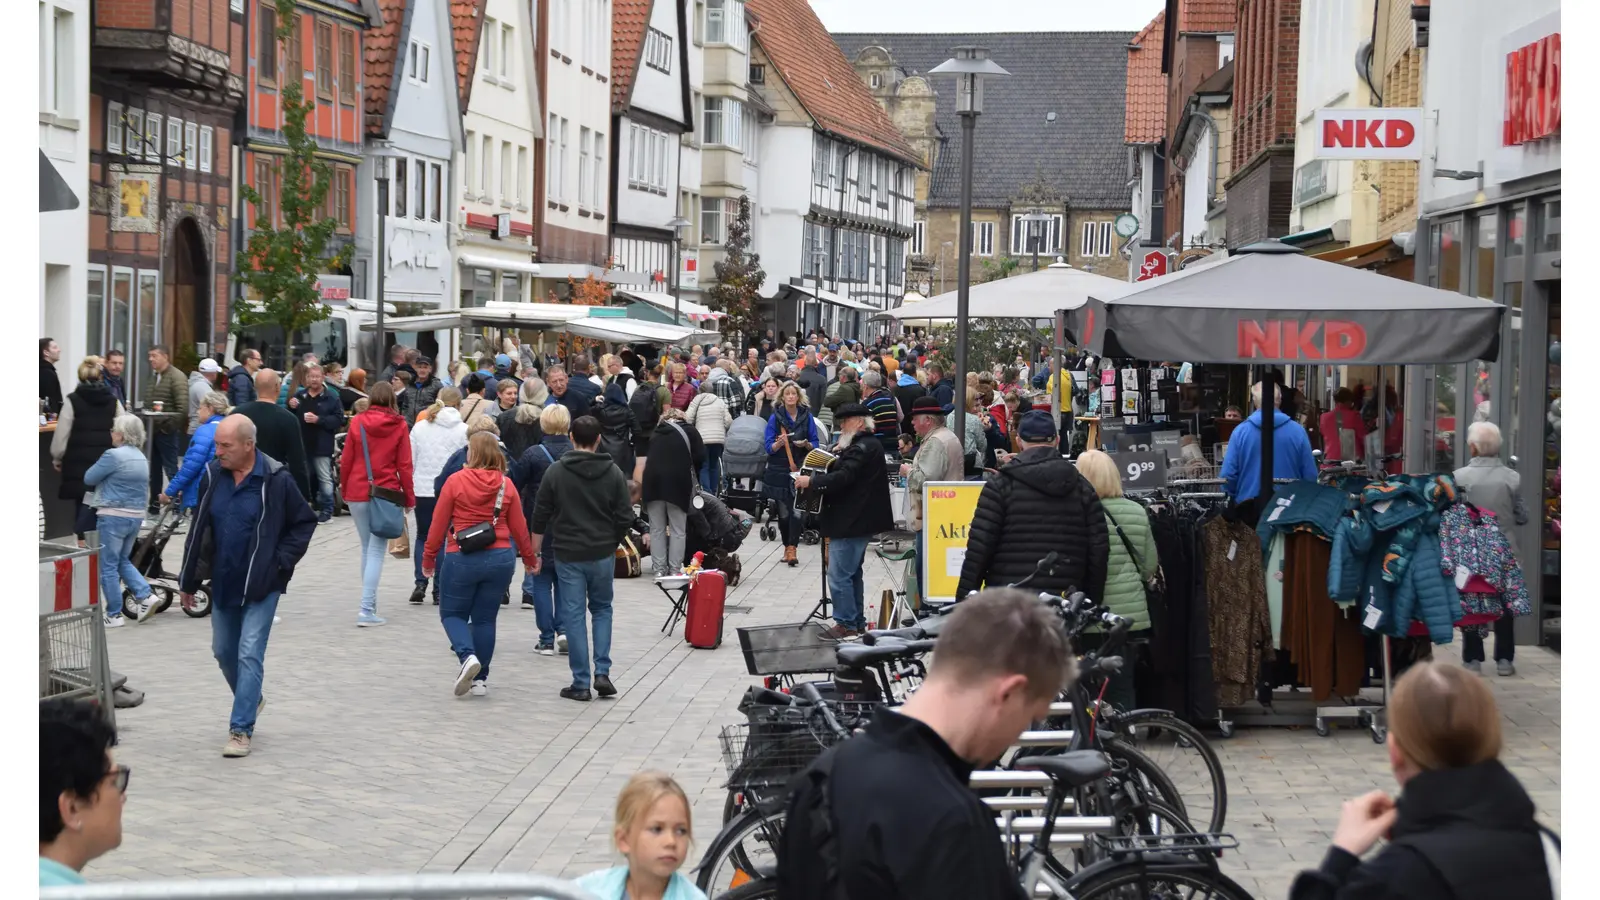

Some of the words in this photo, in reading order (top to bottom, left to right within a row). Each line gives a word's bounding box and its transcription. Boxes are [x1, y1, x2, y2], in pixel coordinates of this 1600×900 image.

[1323, 120, 1415, 148] NKD
[1237, 319, 1367, 359] NKD
[931, 490, 956, 498] NKD
[935, 522, 970, 538] Akt
